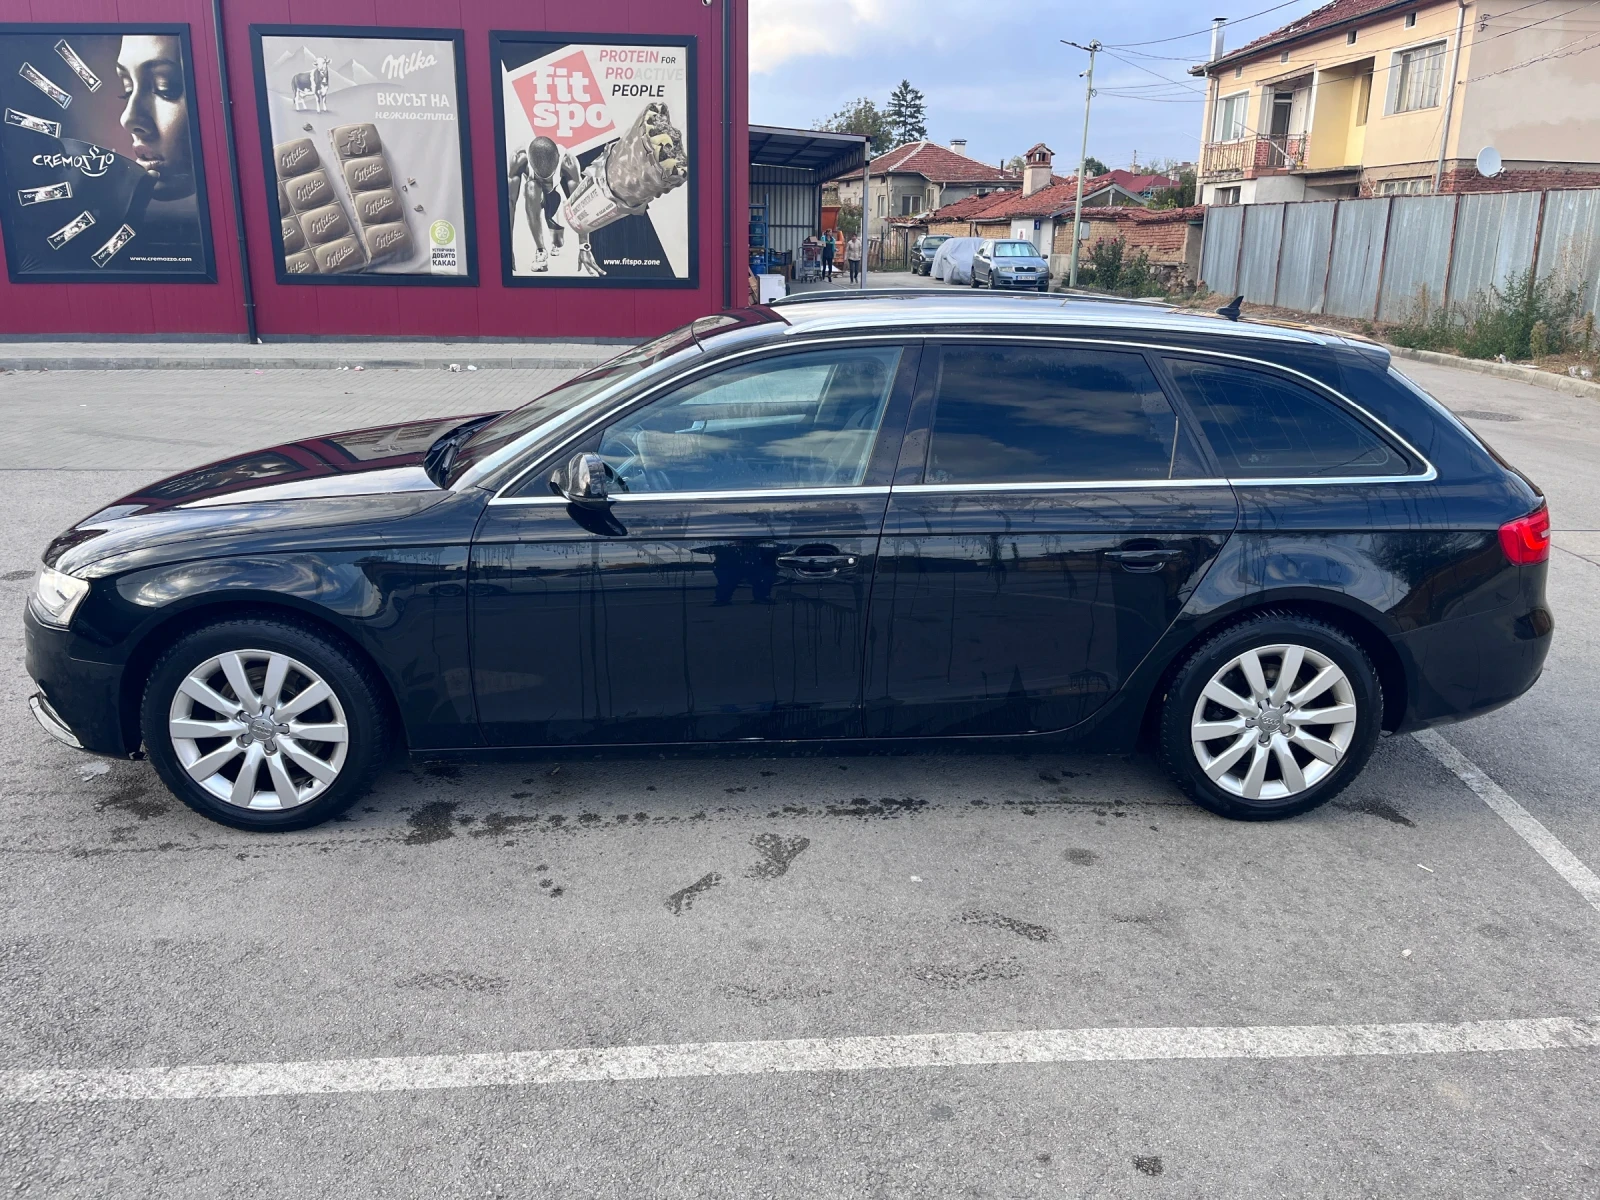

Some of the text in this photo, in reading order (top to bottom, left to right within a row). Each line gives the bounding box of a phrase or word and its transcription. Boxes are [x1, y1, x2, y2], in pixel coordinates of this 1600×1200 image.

[599, 50, 659, 63] PROTEIN
[381, 50, 438, 79] Milka
[605, 67, 684, 81] PROACTIVE
[533, 66, 591, 102] fit
[612, 84, 665, 97] PEOPLE
[377, 92, 450, 107] ВКУСЪТ НА
[375, 111, 456, 121] нежността
[533, 102, 612, 137] spo
[603, 258, 660, 266] www.fitspo.zone
